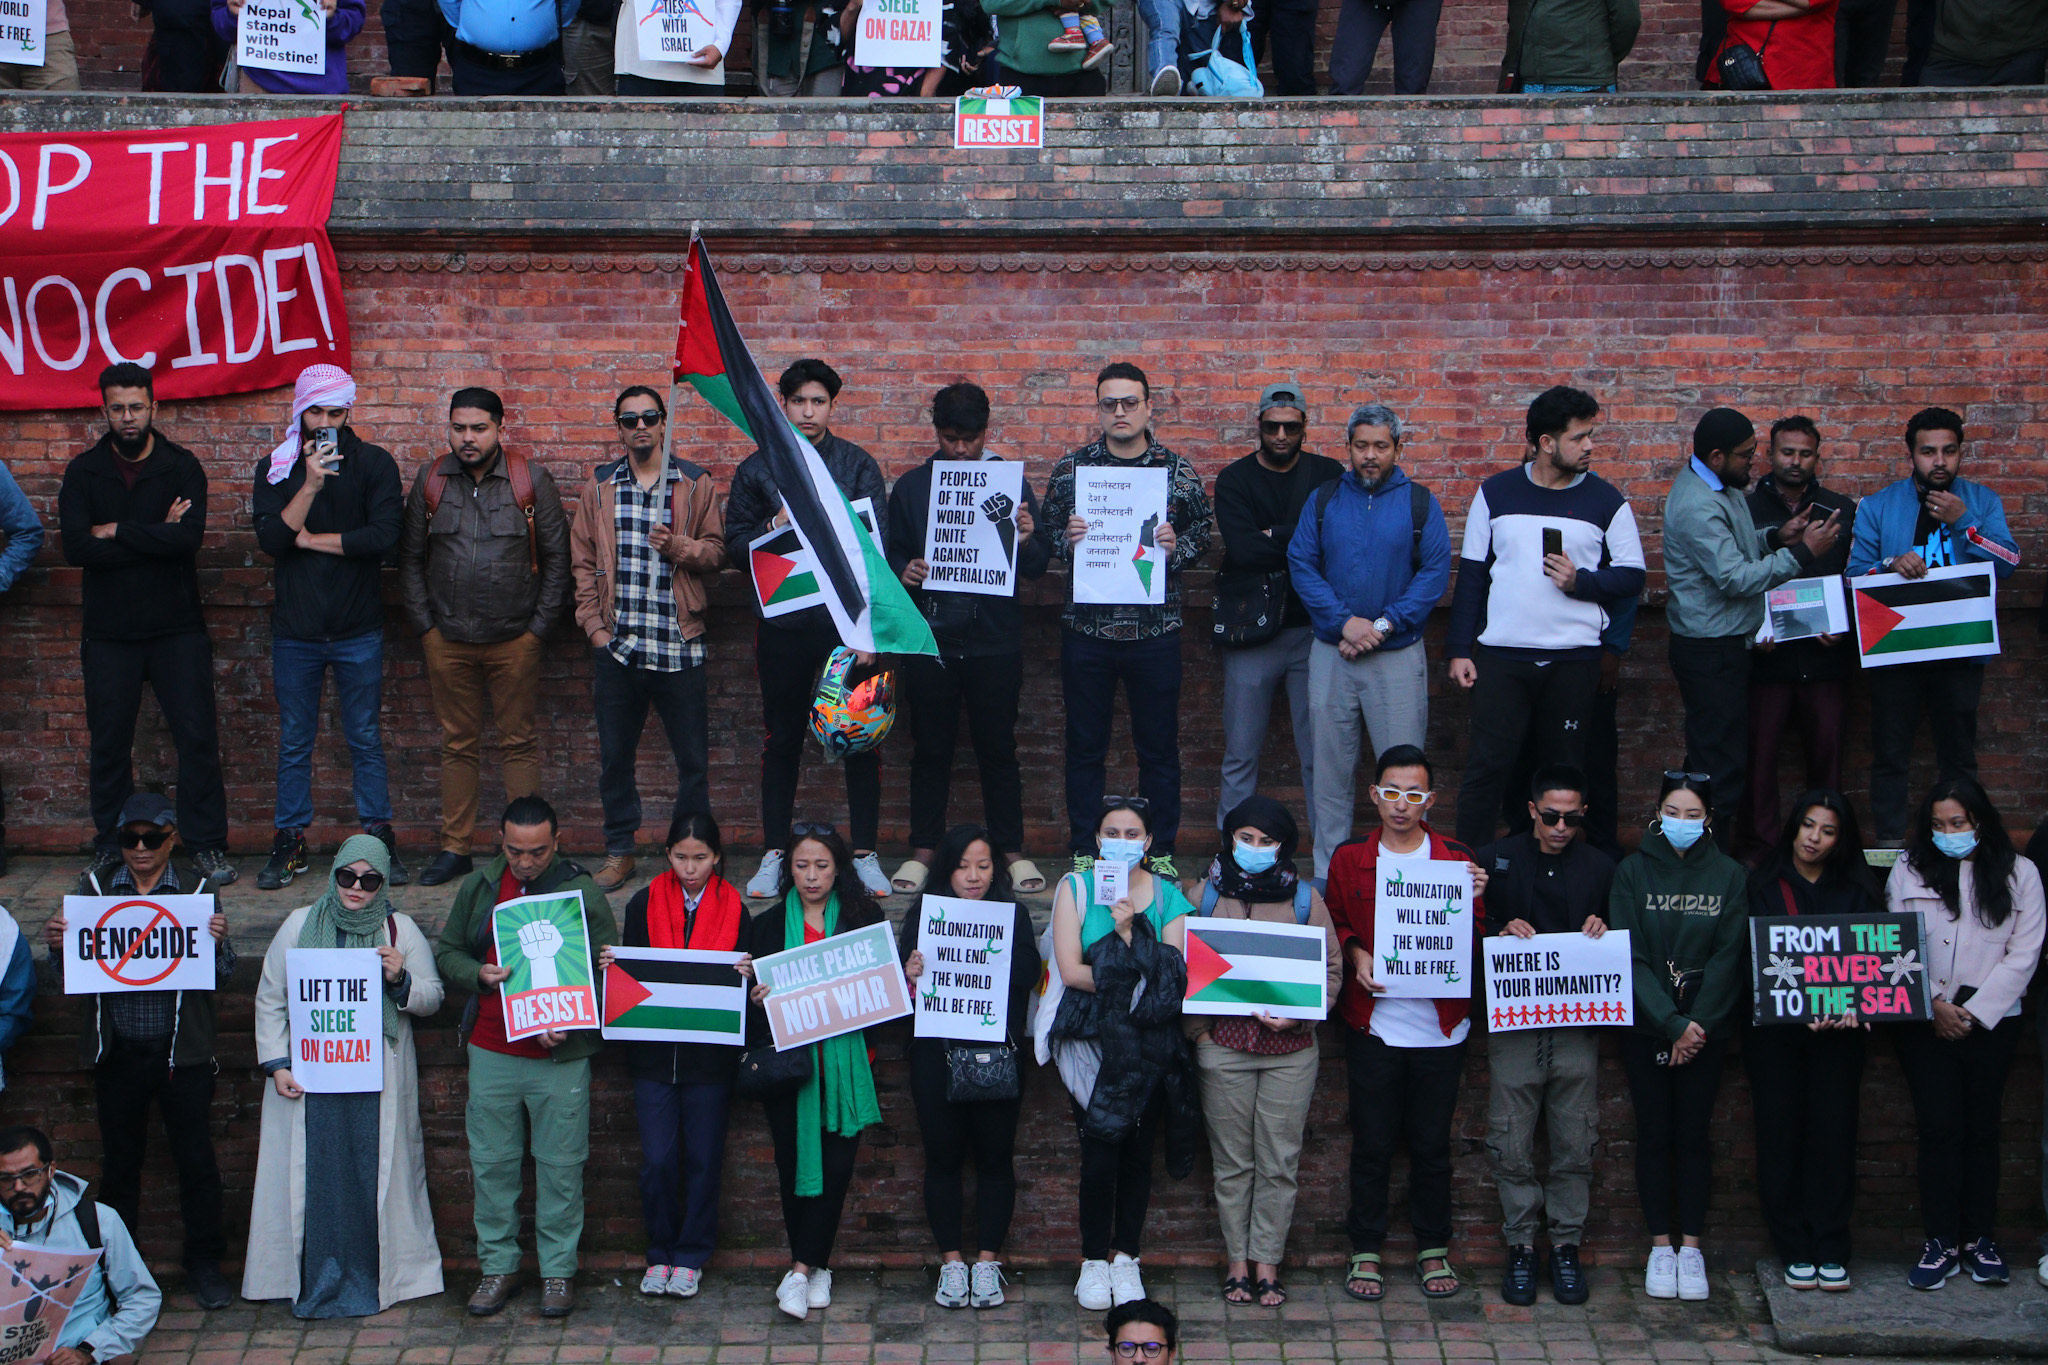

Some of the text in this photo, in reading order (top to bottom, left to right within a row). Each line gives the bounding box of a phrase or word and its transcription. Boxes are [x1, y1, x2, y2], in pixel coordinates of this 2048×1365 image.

[247, 4, 290, 19] Nepal
[663, 0, 685, 14] TIES
[878, 0, 920, 14] SIEGE
[8, 26, 34, 43] FREE.
[246, 20, 296, 34] stands
[662, 18, 687, 33] WITH
[866, 18, 931, 41] ON GAZA!
[246, 34, 279, 46] with
[661, 37, 694, 52] ISRAEL
[246, 46, 318, 64] Palestine!
[963, 118, 1036, 143] RESIST.
[128, 133, 298, 225] THE
[940, 471, 987, 487] PEOPLES
[1088, 480, 1131, 490] प्यालेस्टाइन
[938, 490, 975, 506] OF THE
[1088, 493, 1101, 502] देश
[937, 509, 975, 525] WORLD
[934, 528, 967, 543] UNITE
[932, 547, 979, 563] AGAINST
[931, 566, 1007, 586] IMPERIALISM
[1386, 881, 1462, 900] COLONIZATION
[1396, 908, 1450, 925] WILL END.
[928, 919, 1004, 940] COLONIZATION
[1769, 924, 1902, 953] FROM THE
[79, 927, 199, 961] GENOCIDE
[1393, 934, 1453, 951] THE WORLD
[770, 938, 877, 990] MAKE PEACE
[937, 947, 990, 965] WILL END.
[1492, 951, 1560, 973] WHERE IS
[1385, 960, 1459, 976] WILL BE FREE.
[1803, 954, 1883, 983] RIVER
[932, 971, 992, 990] THE WORLD
[1493, 973, 1622, 998] YOUR HUMANITY?
[300, 979, 367, 1002] LIFT THE
[780, 975, 891, 1036] NOT WAR
[923, 996, 996, 1016] WILL BE FREE.
[1770, 986, 1912, 1017] TO THE SEA
[511, 991, 592, 1031] RESIST.
[311, 1009, 356, 1033] SIEGE
[301, 1038, 371, 1063] ON GAZA!
[5, 1321, 43, 1339] STOP
[18, 1326, 46, 1342] THE
